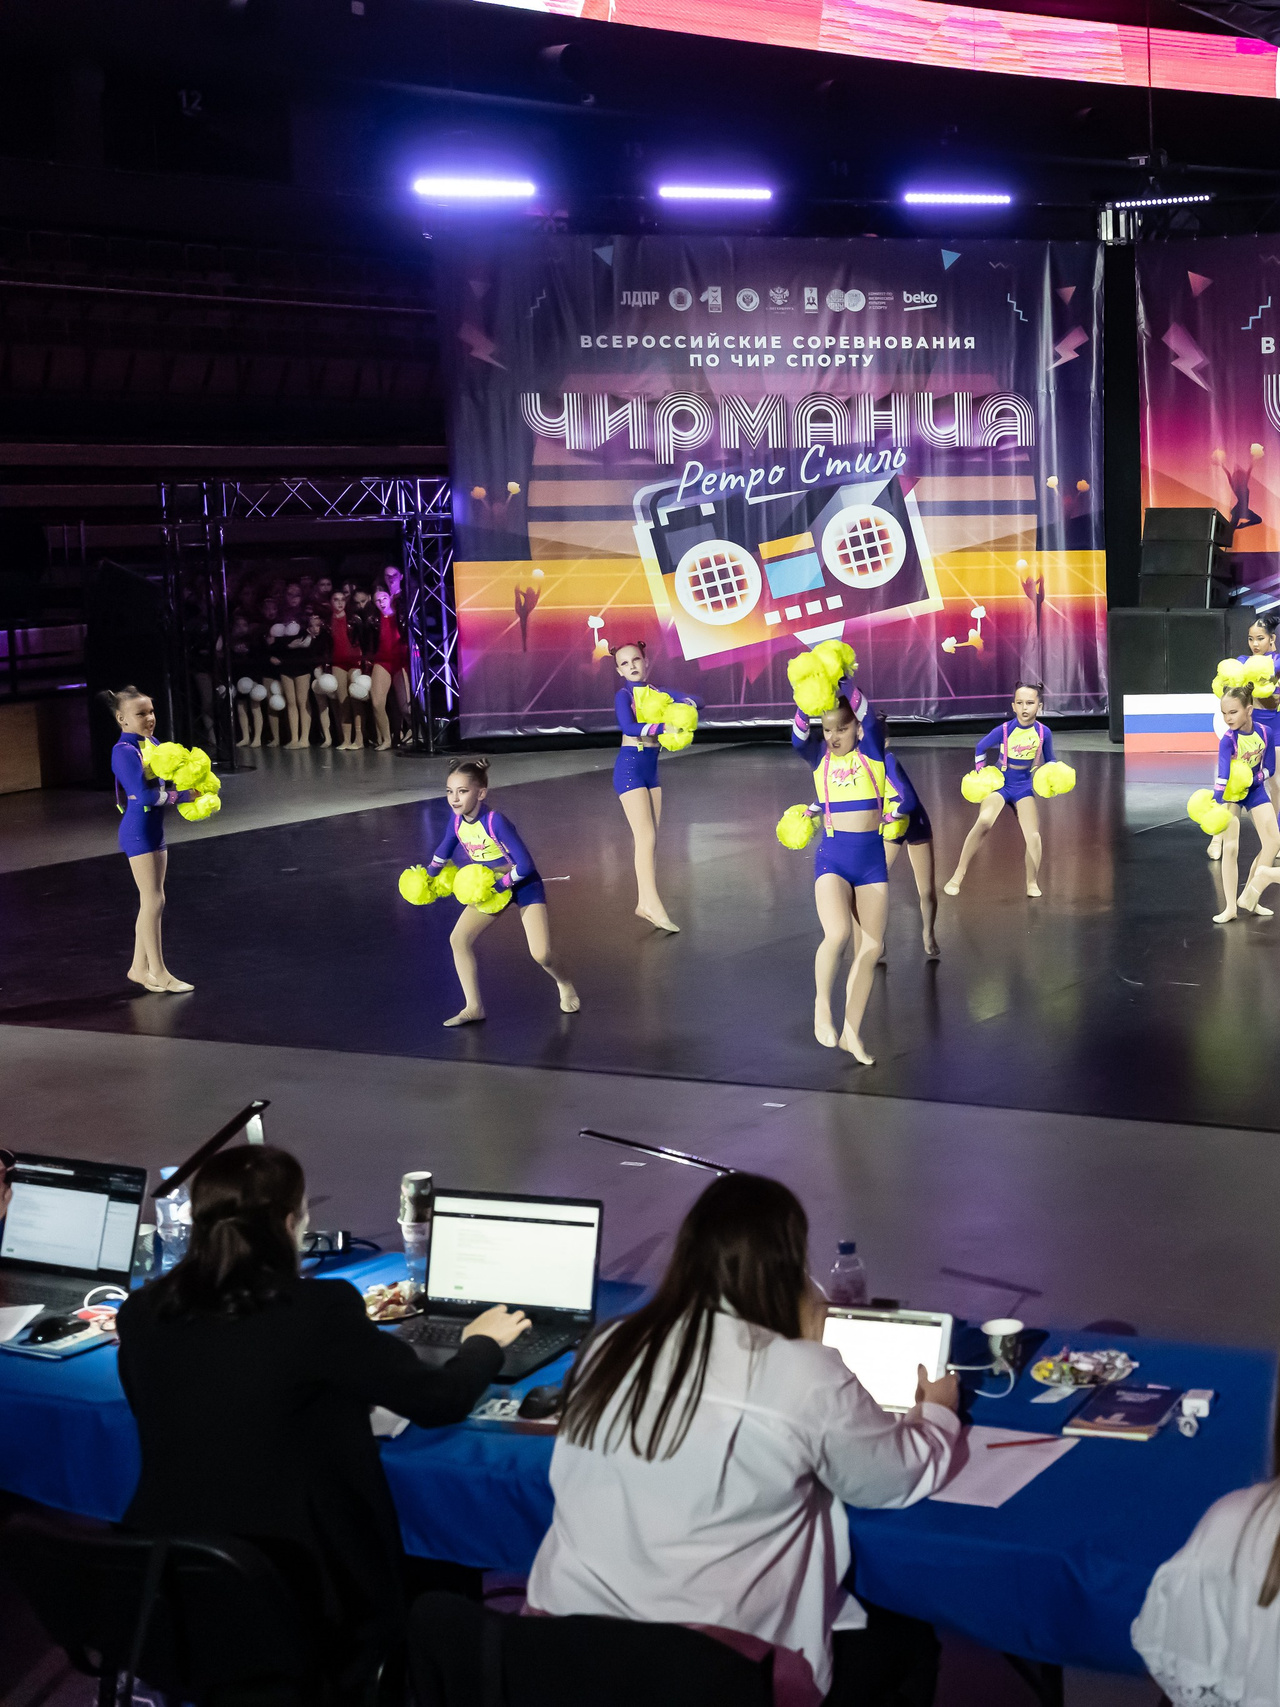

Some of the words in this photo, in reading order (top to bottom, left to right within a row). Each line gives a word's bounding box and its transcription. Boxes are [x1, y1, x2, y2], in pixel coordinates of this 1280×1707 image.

[620, 291, 660, 308] ЛДПР
[903, 290, 938, 304] beko
[580, 331, 782, 350] ВСЕРОССИЙСКИЕ
[792, 335, 976, 350] СОРЕВНОВАНИЯ
[689, 353, 720, 367] ПО
[730, 354, 776, 367] ЧИР
[786, 354, 874, 368] СПОРТУ
[676, 460, 786, 503] Ретро
[800, 443, 908, 485] Стиль
